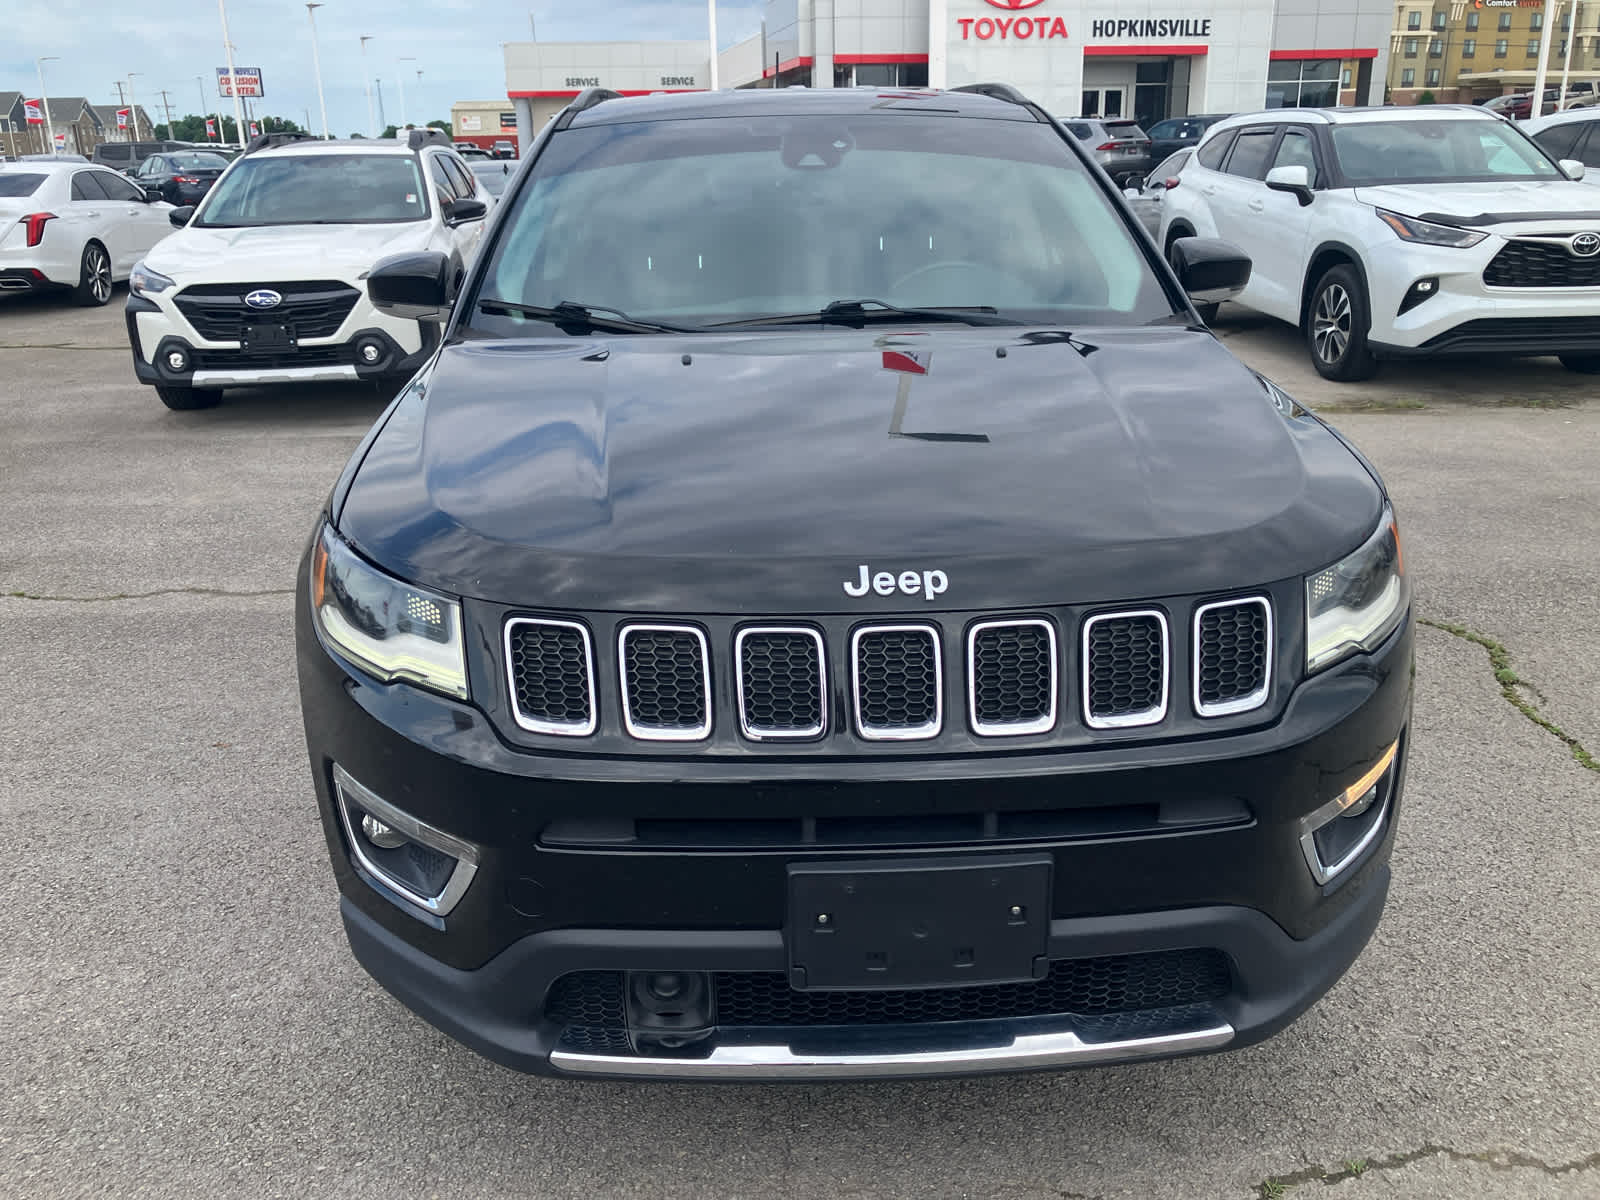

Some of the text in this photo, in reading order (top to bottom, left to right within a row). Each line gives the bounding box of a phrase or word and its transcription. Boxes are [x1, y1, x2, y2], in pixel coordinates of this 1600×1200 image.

[957, 16, 1068, 40] TOYOTA
[1092, 19, 1211, 37] HOPKINSVILLE
[565, 77, 600, 87] SERVICE
[661, 76, 695, 86] SERVICE
[843, 565, 948, 600] Jeep
